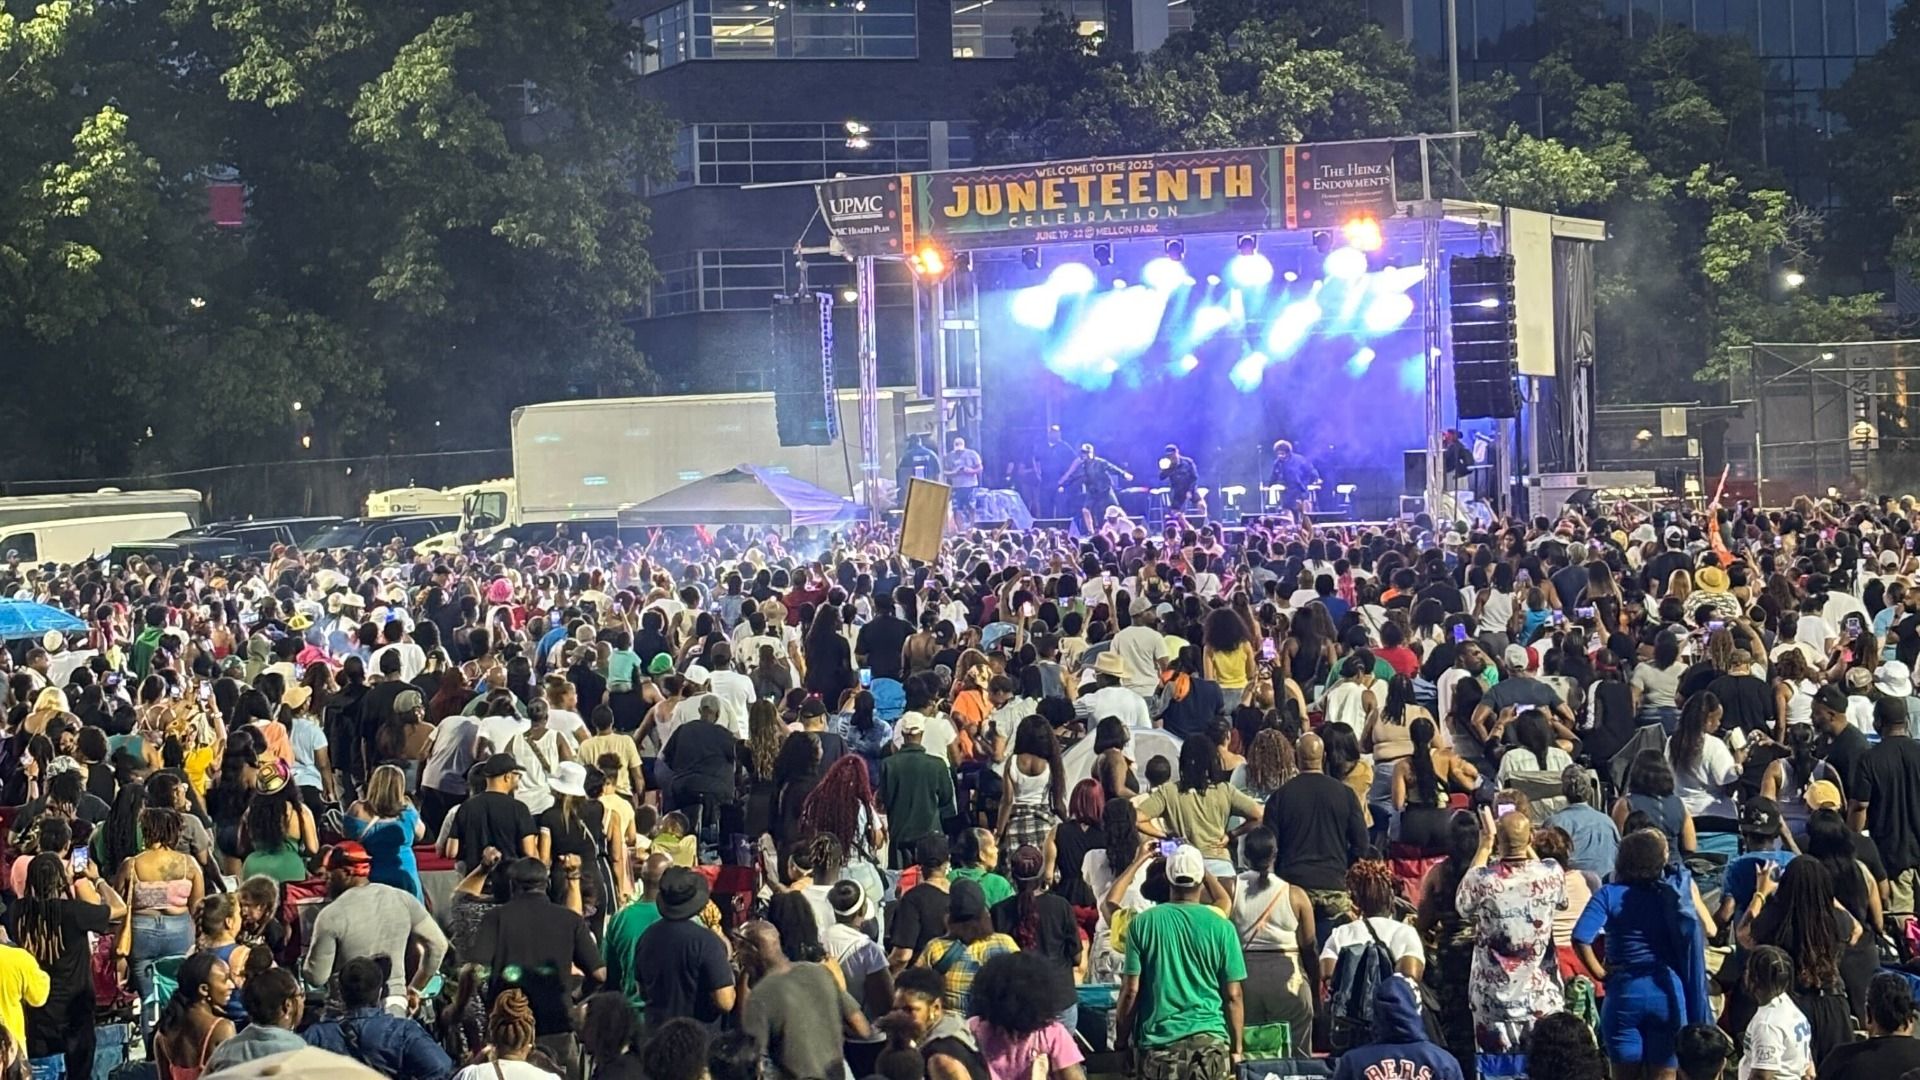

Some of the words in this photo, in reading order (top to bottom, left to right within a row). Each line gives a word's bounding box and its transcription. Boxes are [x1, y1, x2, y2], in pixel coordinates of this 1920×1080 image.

[1035, 164, 1088, 177] WELCOME
[1091, 162, 1105, 172] TO
[1107, 161, 1126, 171] THE
[1128, 160, 1154, 170] 2025
[1320, 164, 1345, 177] THE
[1348, 163, 1382, 176] HEINZ
[943, 164, 1253, 218] JUNETEENTH
[1313, 177, 1390, 190] ENDOWMENTS
[829, 195, 883, 215] UPMC
[1008, 206, 1178, 228] CELEBRATION
[1035, 230, 1058, 241] JUNE
[1096, 226, 1132, 236] MELLON
[1133, 224, 1159, 234] PARK
